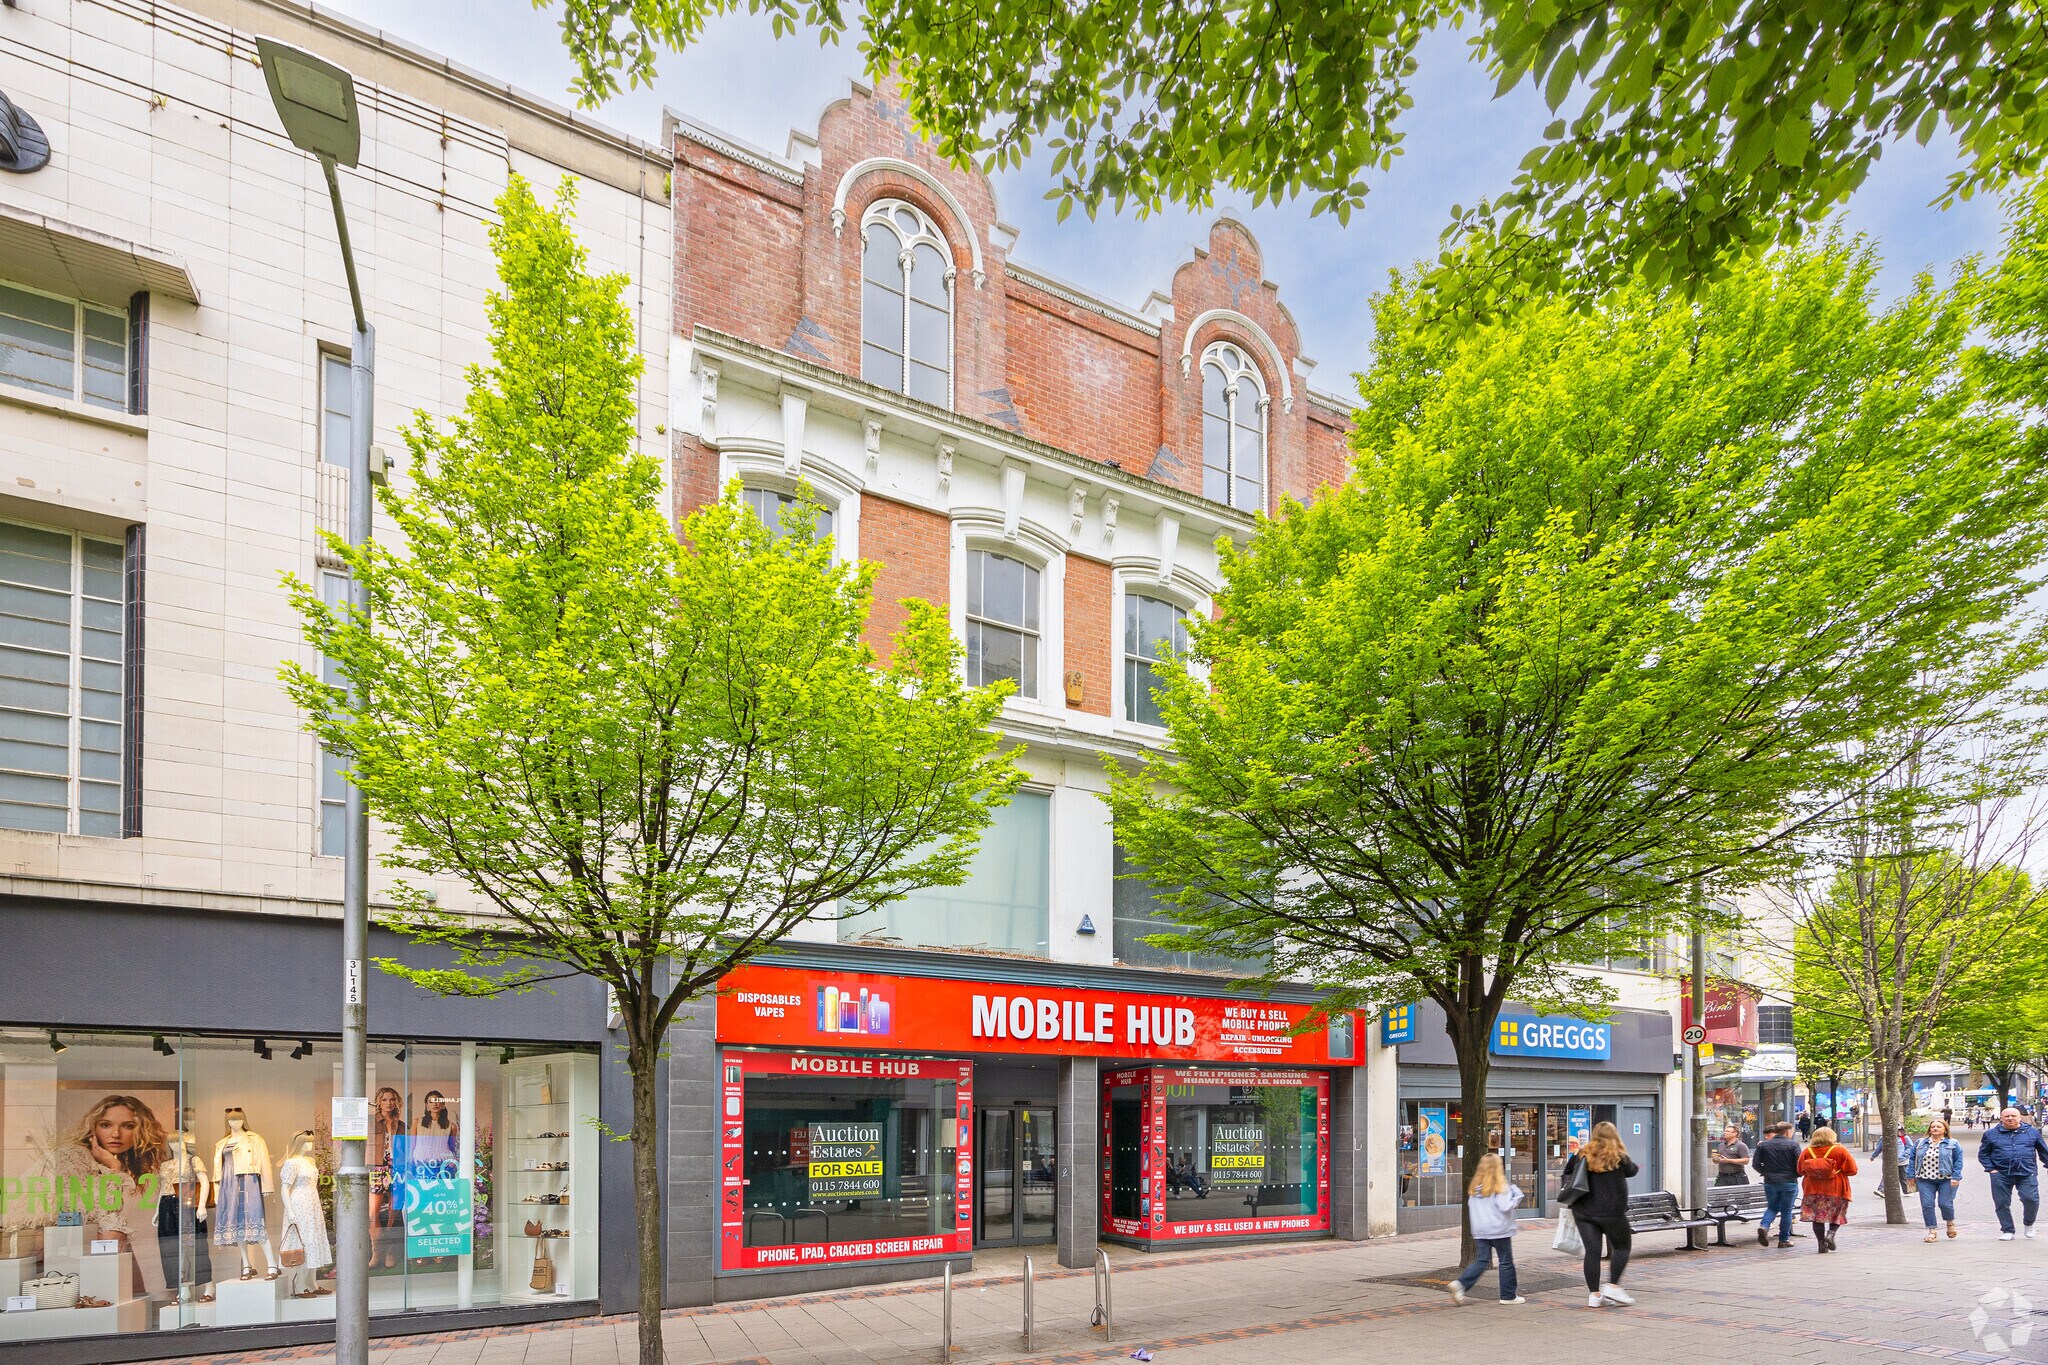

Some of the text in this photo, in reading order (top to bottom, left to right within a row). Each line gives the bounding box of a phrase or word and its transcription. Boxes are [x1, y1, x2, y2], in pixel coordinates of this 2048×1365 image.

[737, 992, 801, 1006] DISPOSABLES
[754, 1006, 785, 1018] VAPES
[1224, 1007, 1288, 1020] WE BUY & SELL
[972, 994, 1196, 1046] MOBILE HUB
[1222, 1019, 1291, 1031] MOBILE PHONES
[1220, 1033, 1246, 1041] REPAIR
[1251, 1035, 1292, 1043] UNLOCKING
[1388, 1031, 1408, 1039] GREGGS
[1523, 1023, 1606, 1051] GREGGS
[1685, 1030, 1703, 1039] 20
[1233, 1047, 1282, 1055] ACCESSORIES
[791, 1058, 920, 1075] MOBILE HUB
[1116, 1071, 1136, 1079] MOBILE
[812, 1125, 879, 1142] Auction
[1214, 1126, 1263, 1140] Auction
[812, 1145, 862, 1158] Estates
[1214, 1142, 1250, 1153] Estates
[1214, 1157, 1262, 1167] FOR SALE
[812, 1164, 841, 1176] FOR
[845, 1163, 880, 1175] SALE
[812, 1179, 880, 1191] 0115 7844 600
[812, 1189, 880, 1197] www.auctionestates.co.uk
[422, 1200, 458, 1215] 40%
[1174, 1219, 1310, 1234] WE BUY & SELL USED & NEW PHONES
[417, 1237, 461, 1246] SELECTED
[429, 1246, 449, 1254] lines
[757, 1238, 943, 1262] IPHONE, IPAD, CRACKED SCREEN REPAIR
